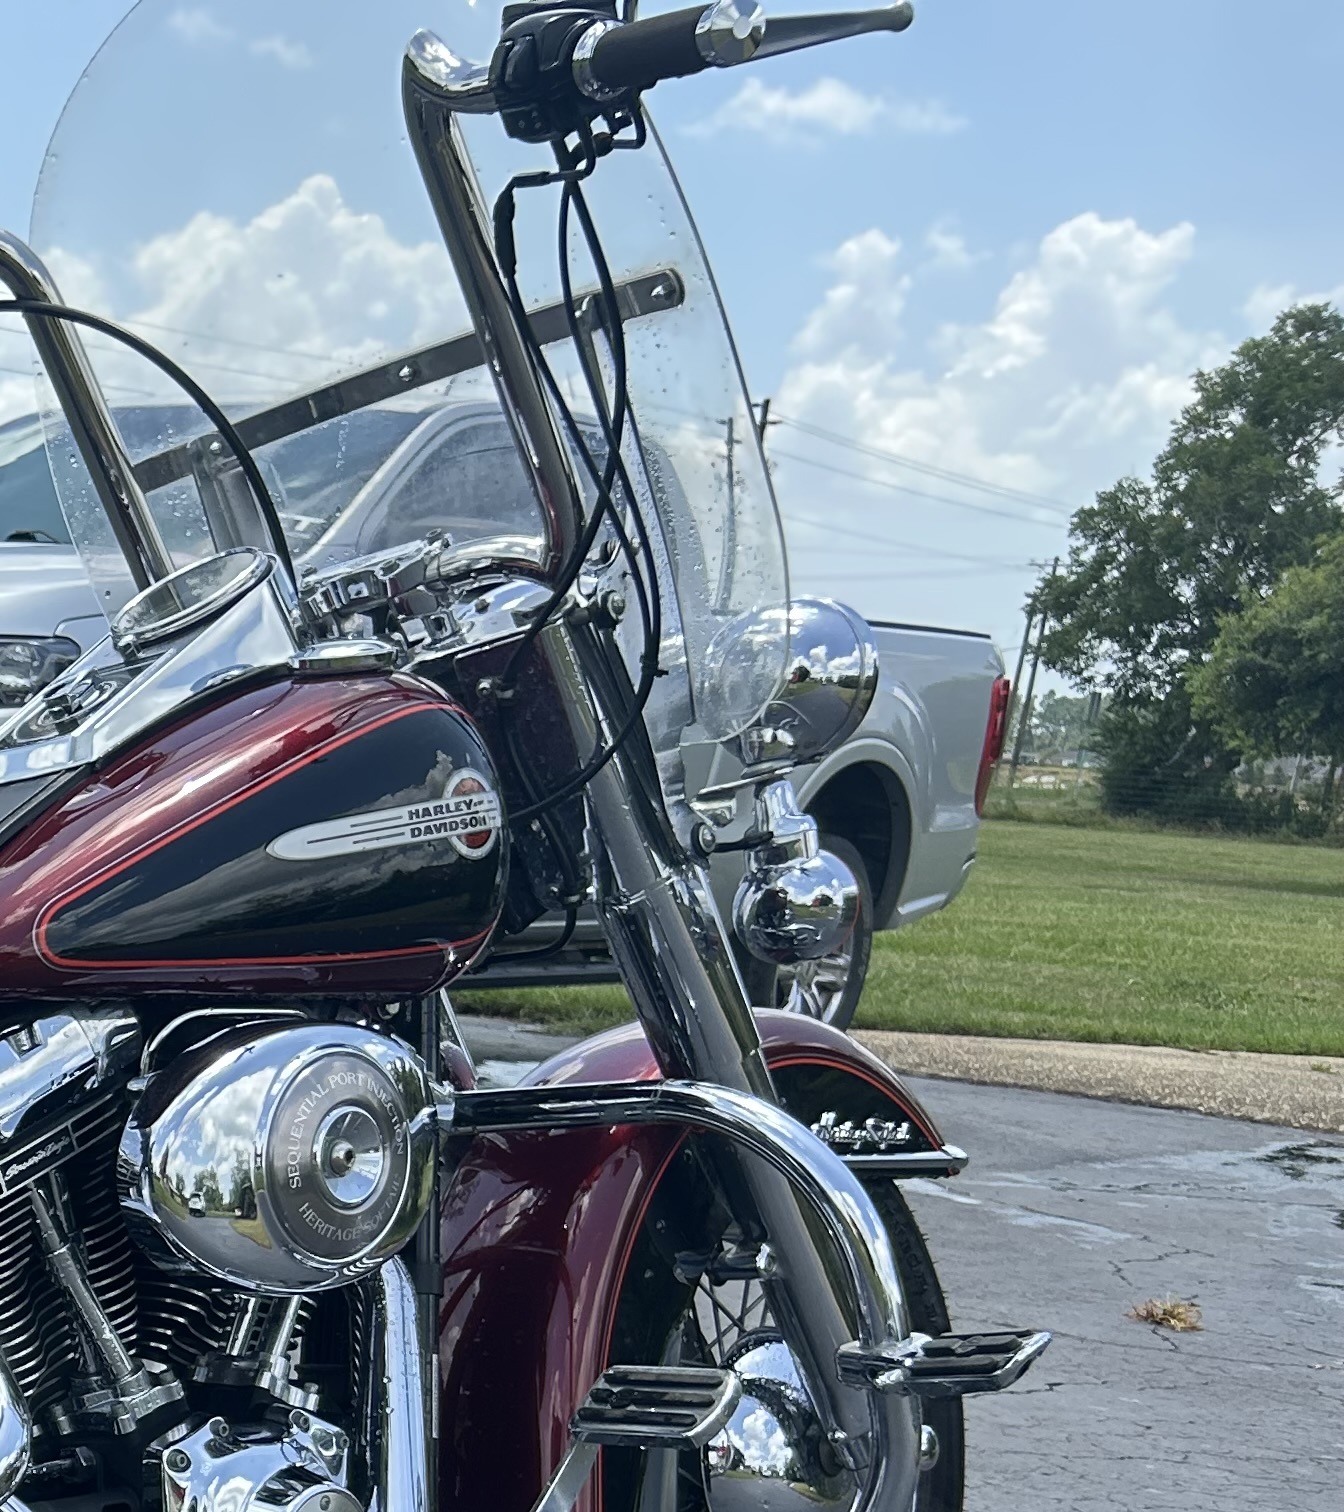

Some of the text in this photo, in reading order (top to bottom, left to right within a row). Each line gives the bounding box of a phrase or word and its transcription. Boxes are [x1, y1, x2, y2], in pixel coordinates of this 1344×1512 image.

[409, 814, 487, 839] DAVIDSON
[287, 1071, 404, 1189] SEQUENTIAL PORT INJECTION
[297, 1201, 361, 1242] HERITAGE
